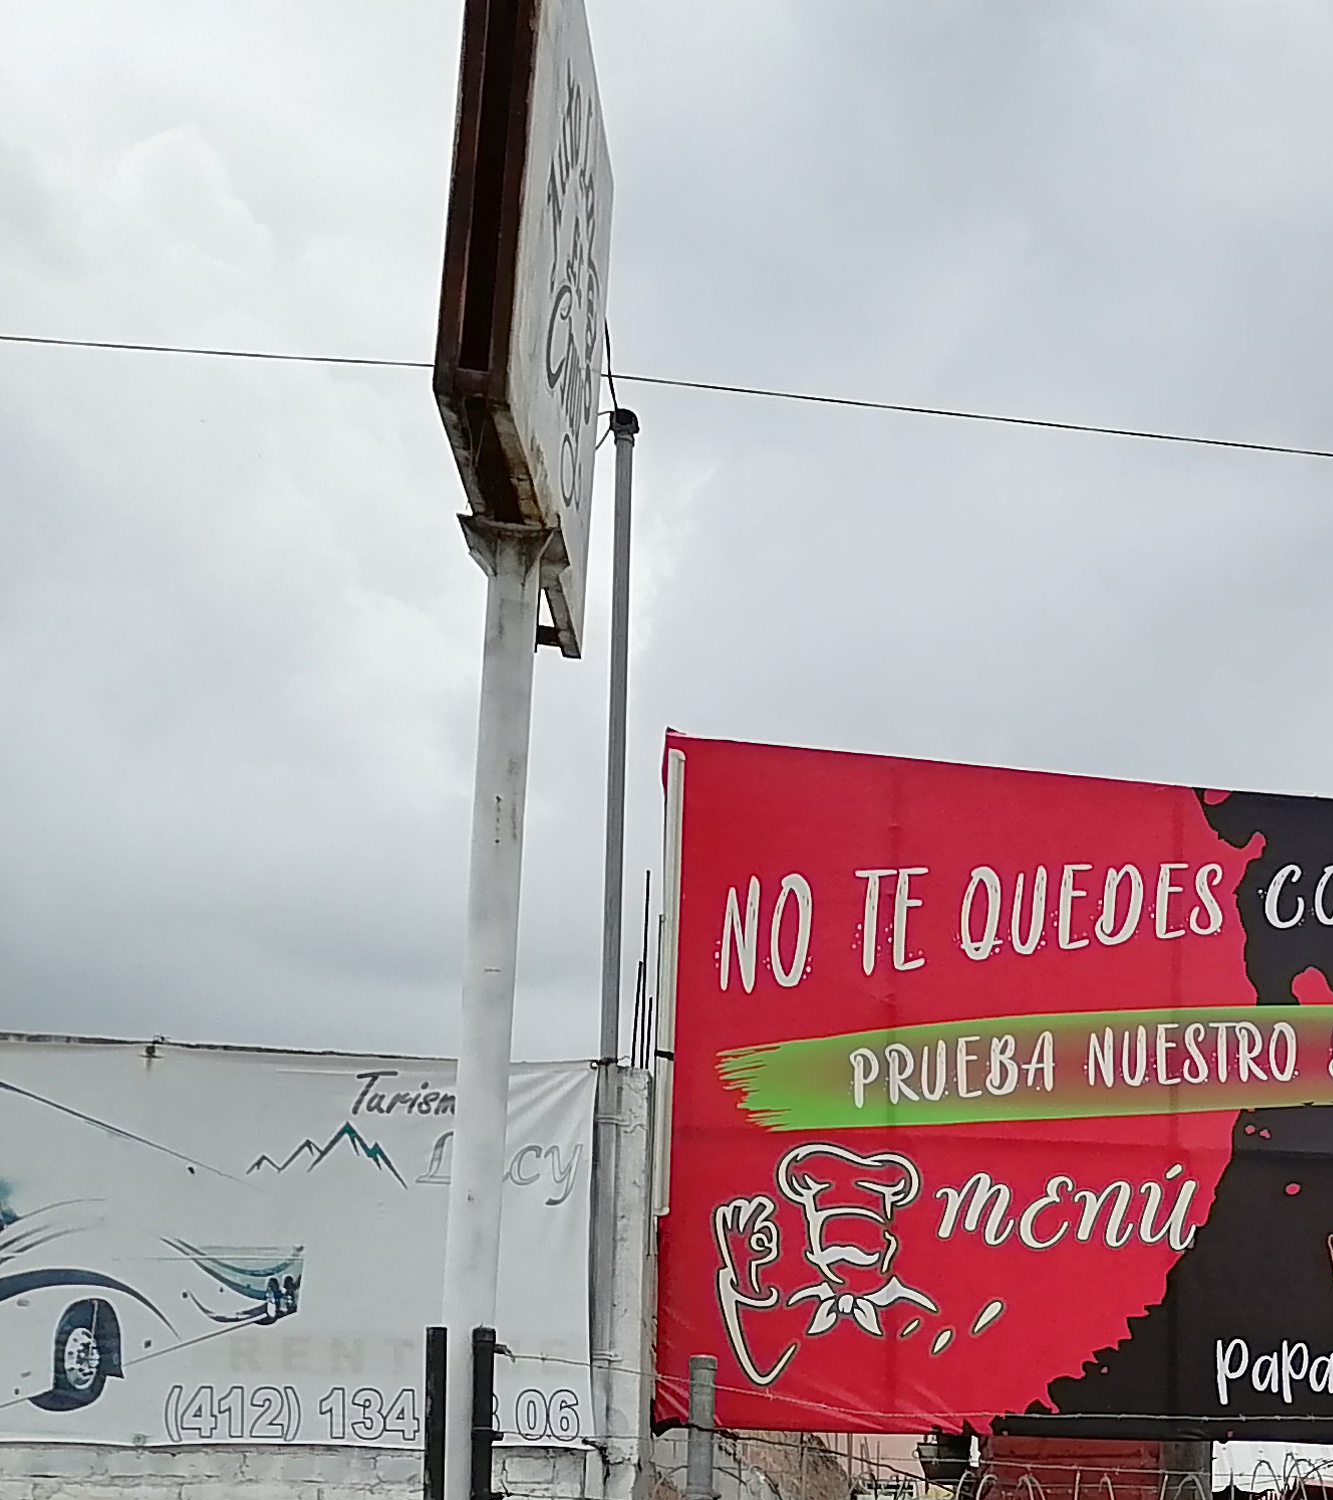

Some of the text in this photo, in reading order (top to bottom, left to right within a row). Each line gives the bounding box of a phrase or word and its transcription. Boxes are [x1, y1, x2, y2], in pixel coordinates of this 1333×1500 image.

[720, 872, 812, 993] NO
[855, 867, 929, 976] TE
[960, 863, 1224, 961] QUEDES
[352, 1071, 456, 1116] Turism
[849, 1030, 1055, 1108] PRUEBA
[1088, 1021, 1297, 1087] NUESTRO
[415, 1130, 584, 1206] Lcy
[164, 1384, 301, 1444] (412)
[318, 1387, 421, 1441] 134
[514, 1388, 581, 1442] 06
